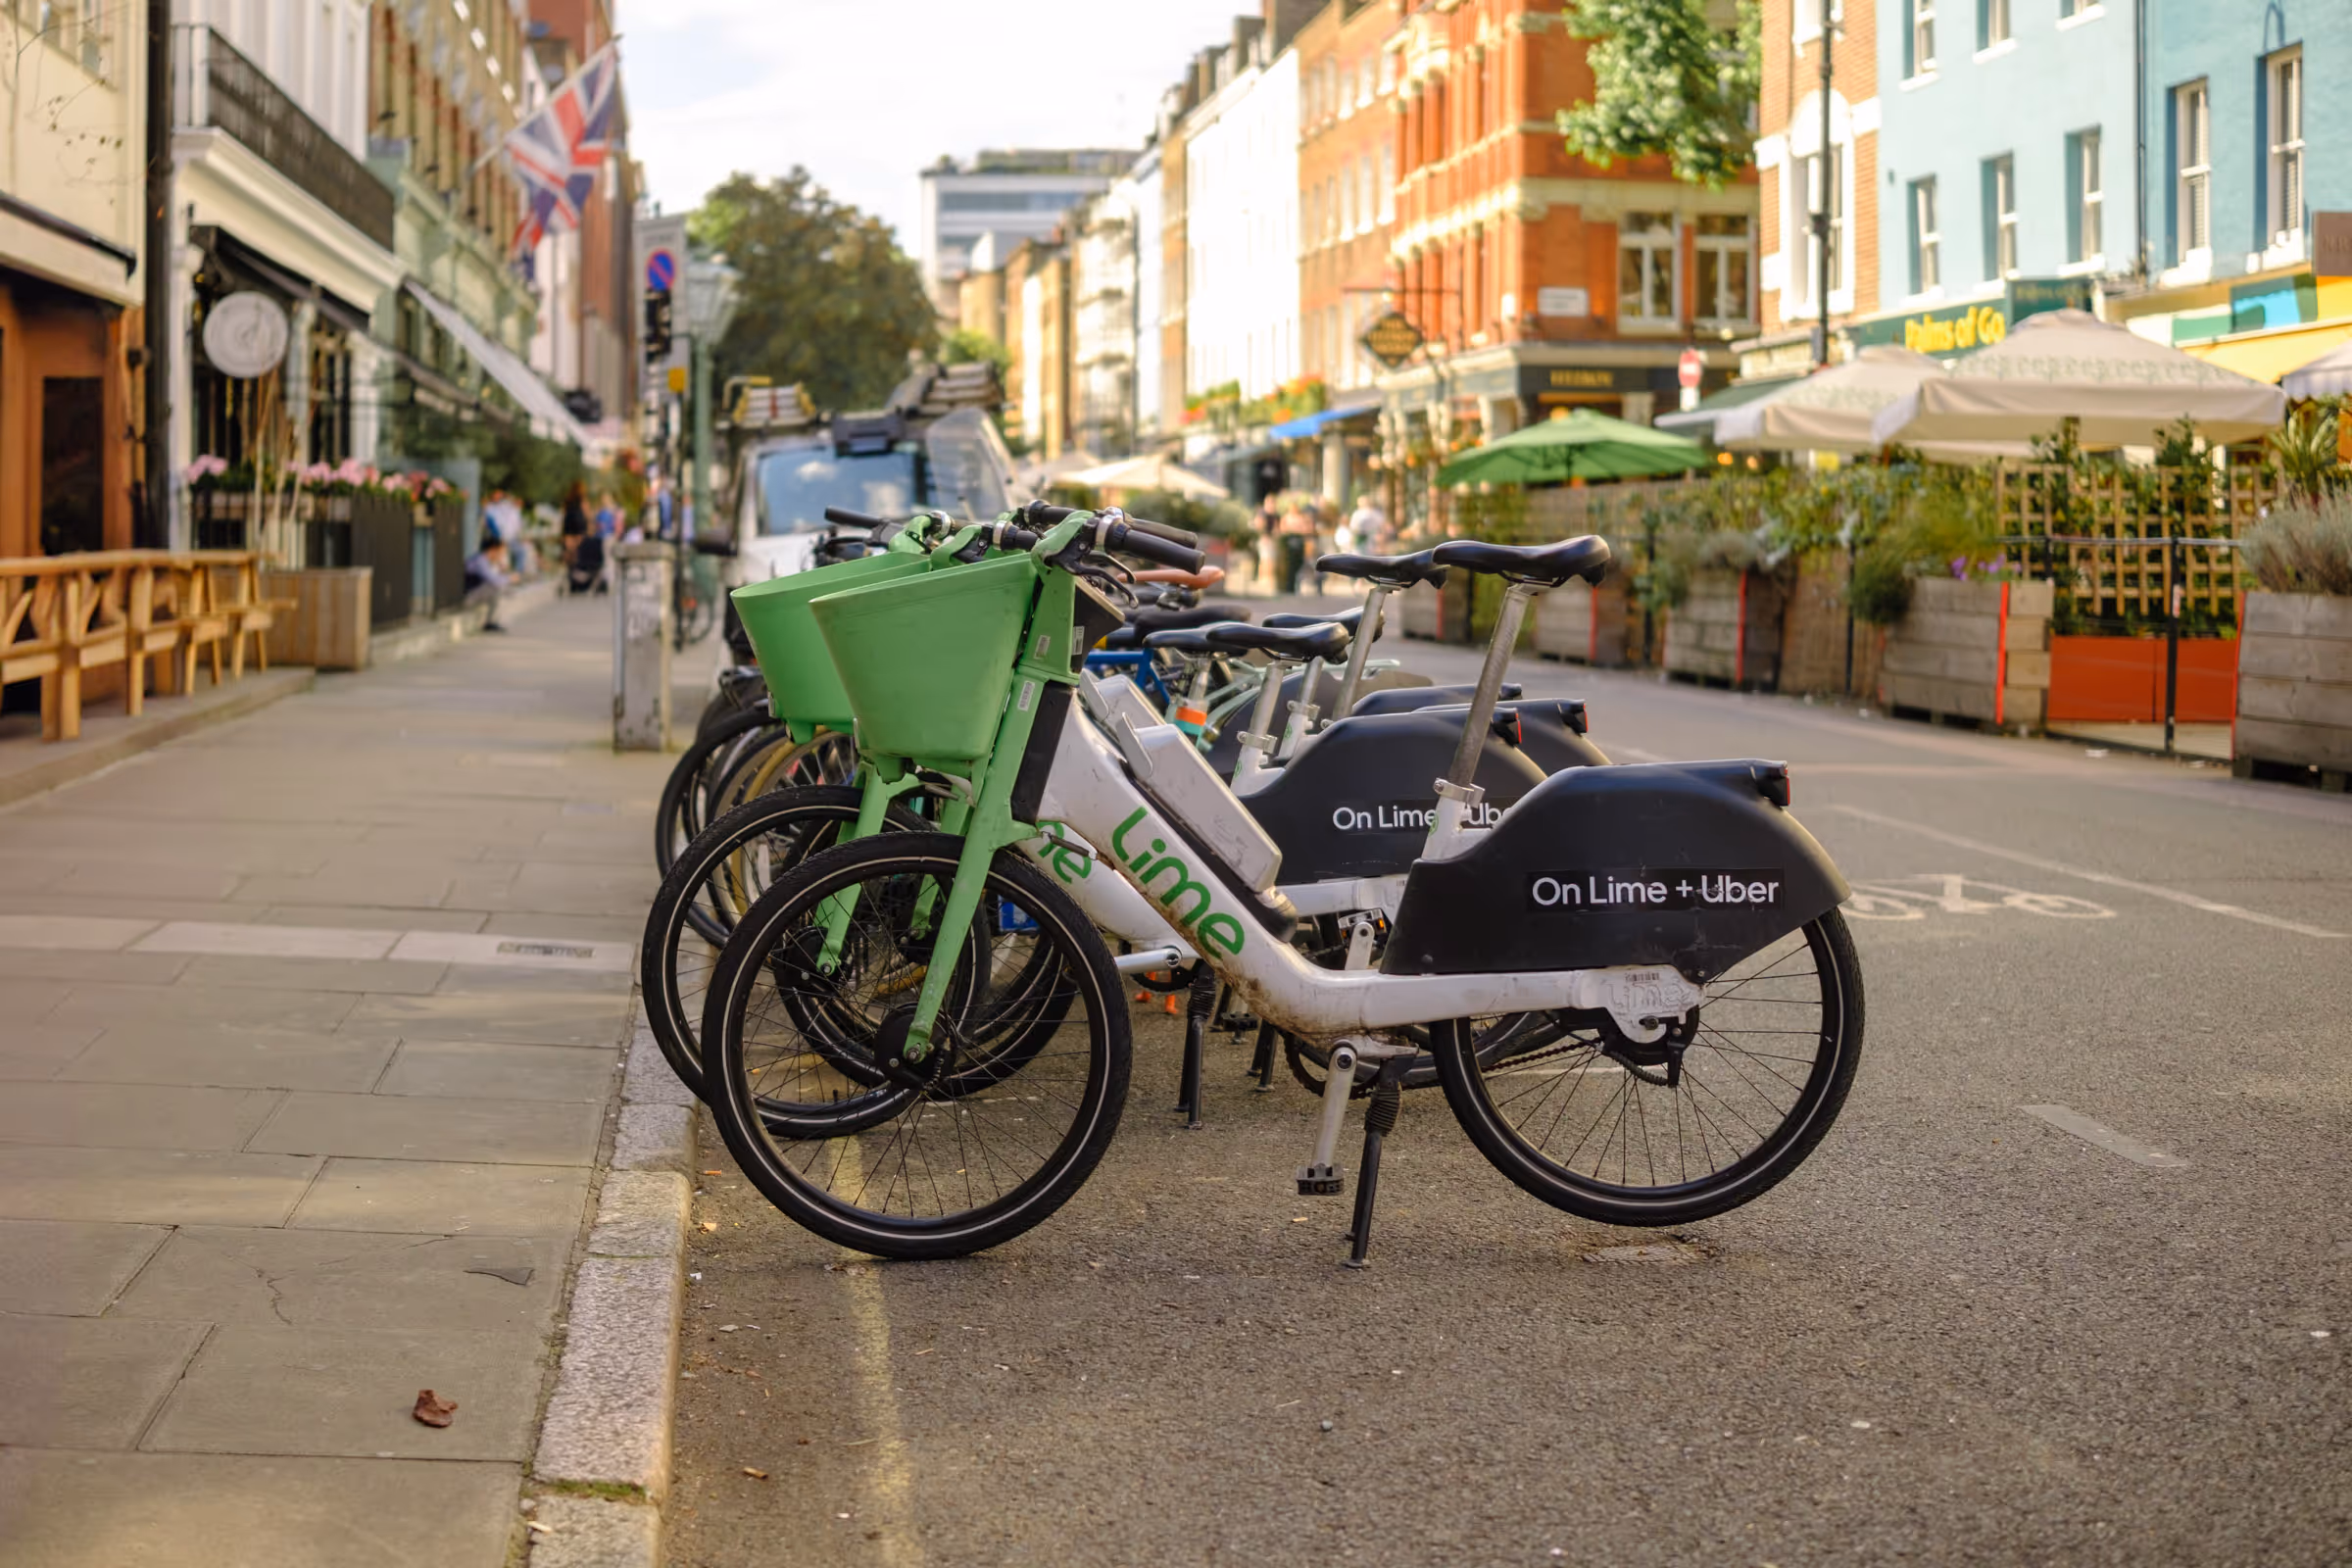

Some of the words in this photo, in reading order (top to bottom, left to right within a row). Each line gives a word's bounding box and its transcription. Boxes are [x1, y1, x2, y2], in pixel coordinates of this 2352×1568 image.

[1904, 314, 1955, 354] Palms
[1955, 306, 1978, 348] of
[1333, 807, 1372, 830] On
[1378, 805, 1437, 828] Lime
[1112, 806, 1245, 960] Lime
[1532, 876, 1581, 906] On
[1589, 875, 1668, 905] Lime
[1675, 879, 1693, 898] +
[1701, 875, 1780, 904] Uber
